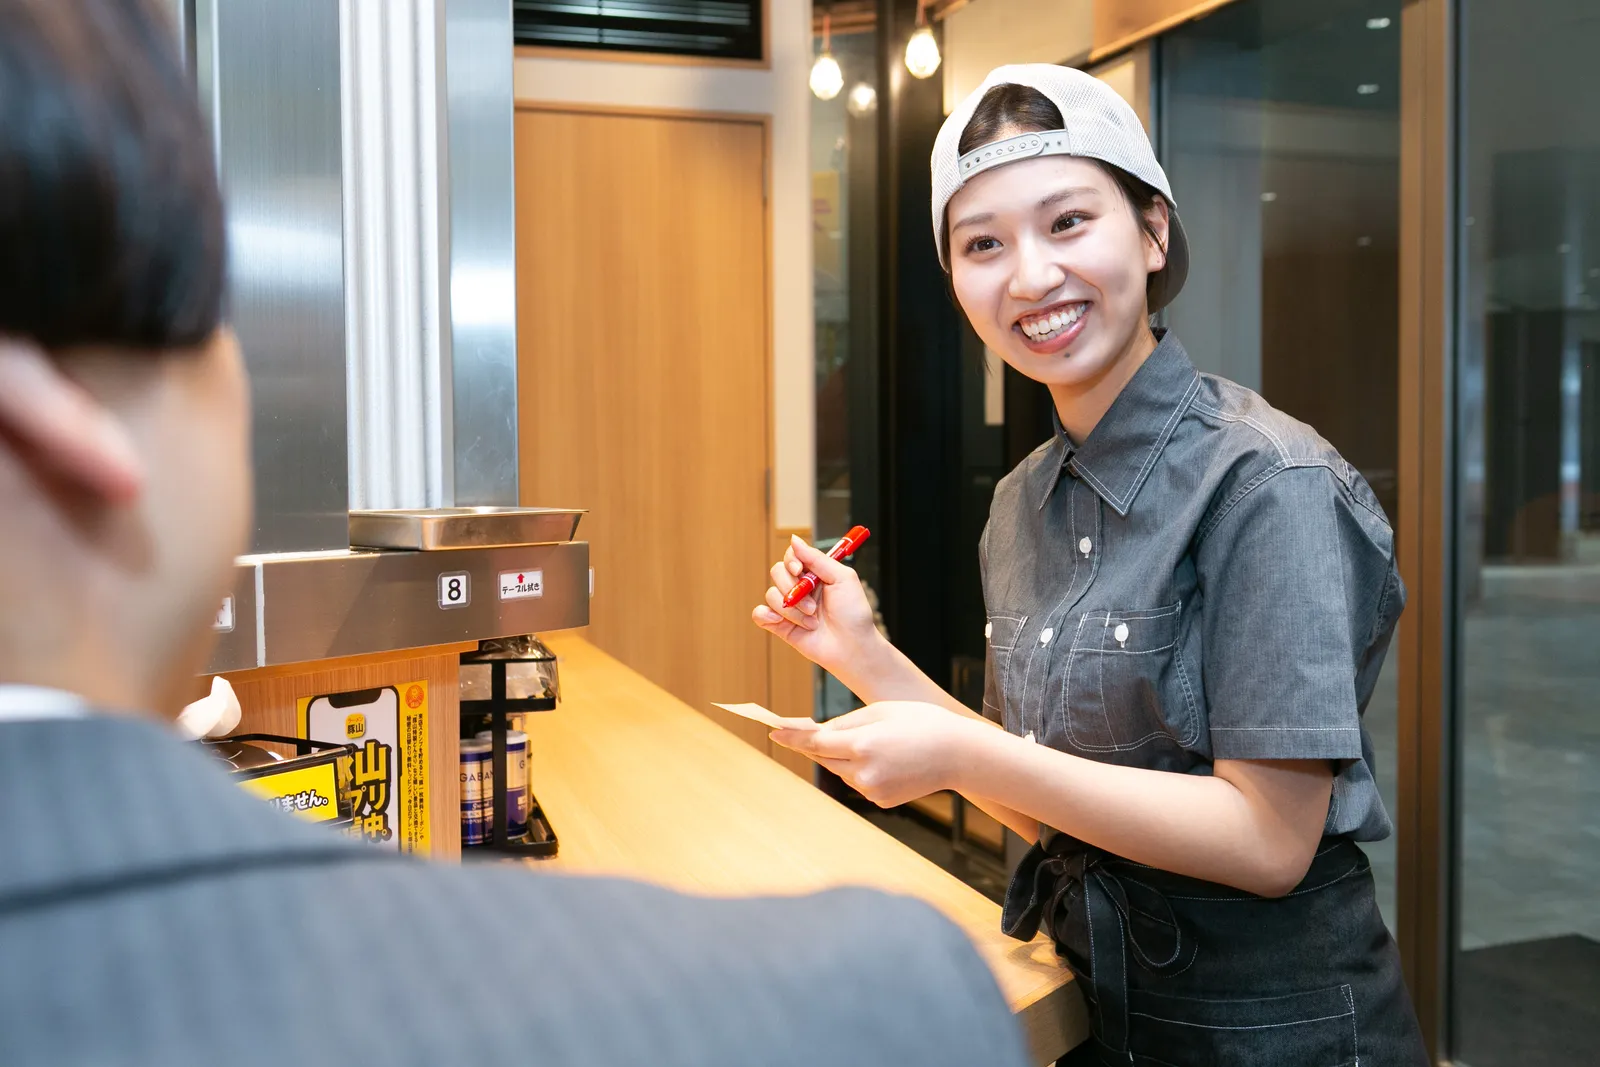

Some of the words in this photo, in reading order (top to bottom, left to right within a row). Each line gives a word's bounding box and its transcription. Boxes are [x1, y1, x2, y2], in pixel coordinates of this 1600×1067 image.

[447, 578, 462, 602] 8
[502, 583, 540, 595] テーブル拭き
[347, 723, 364, 735] 豚山
